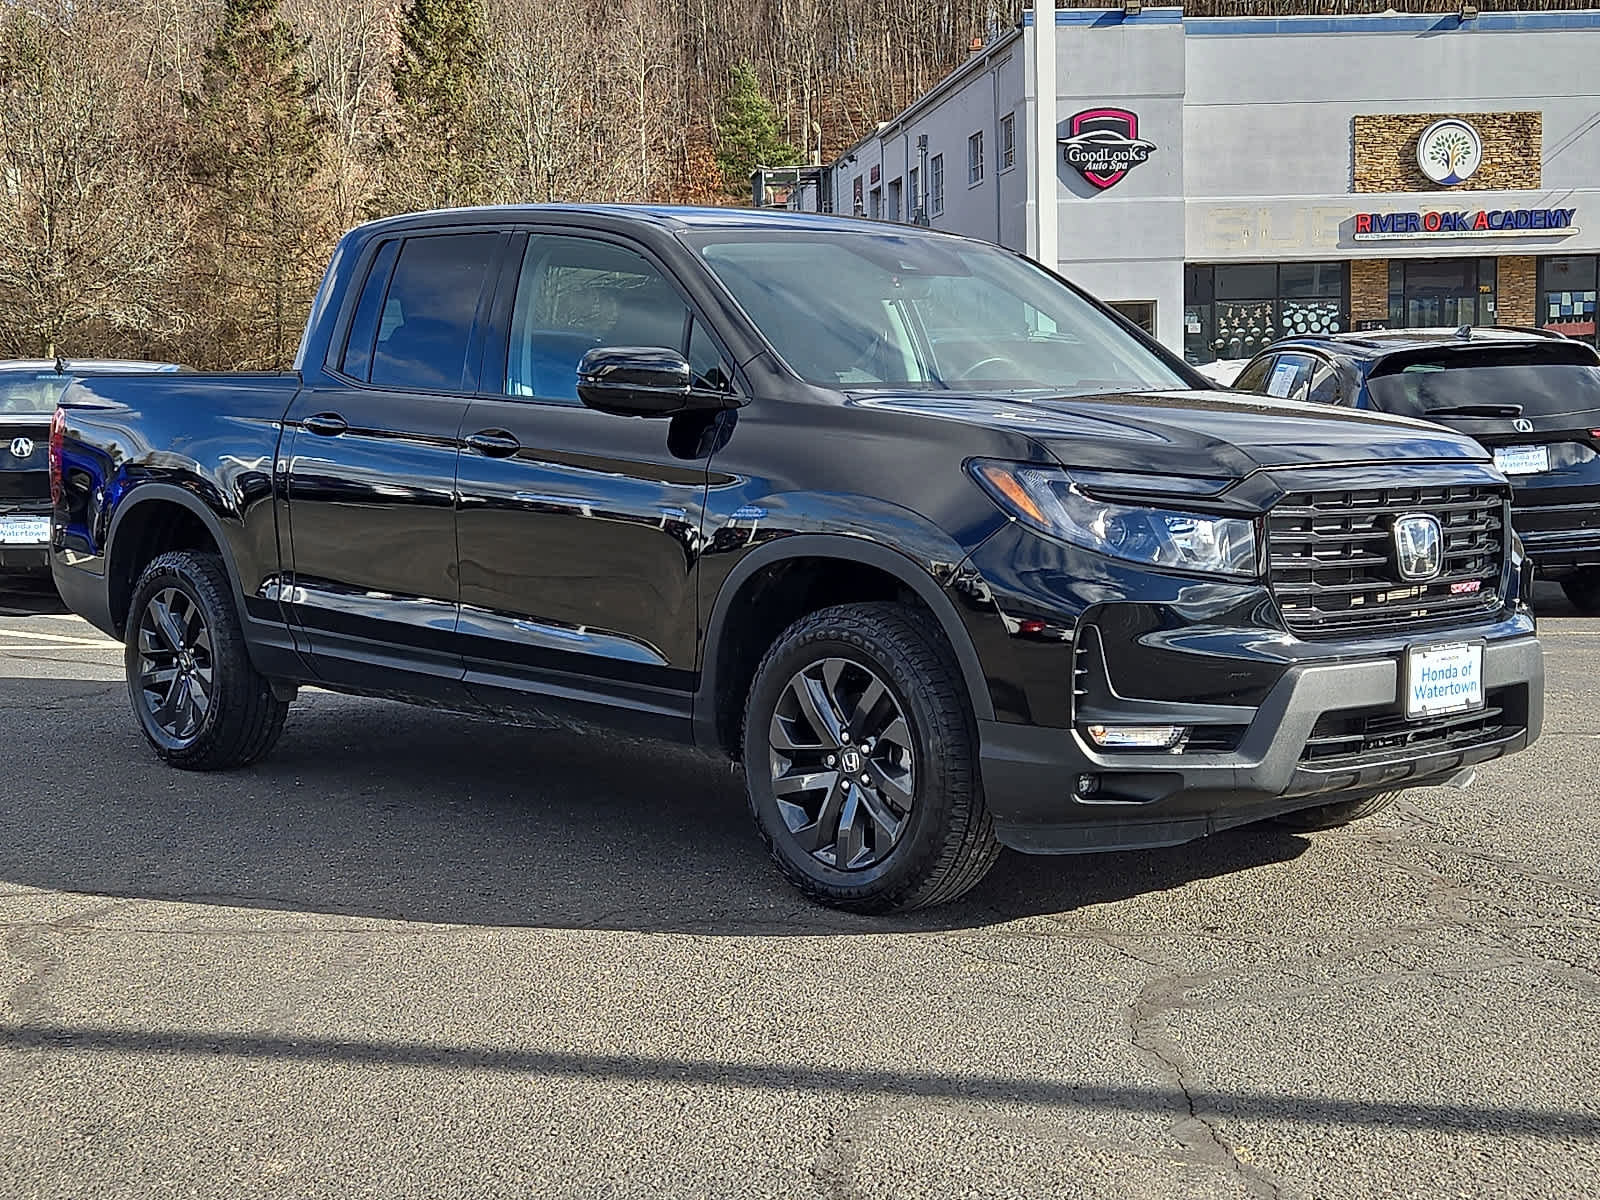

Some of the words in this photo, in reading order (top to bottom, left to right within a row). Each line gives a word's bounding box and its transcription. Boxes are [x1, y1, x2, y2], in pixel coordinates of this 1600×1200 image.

[1084, 161, 1108, 170] Auto
[1109, 160, 1129, 172] Spa
[1356, 212, 1421, 233] RIVER
[1424, 210, 1470, 232] OAK
[1474, 208, 1577, 231] ACADEMY
[1421, 664, 1458, 682] Honda
[1461, 660, 1472, 677] of
[1414, 681, 1477, 700] Watertown
